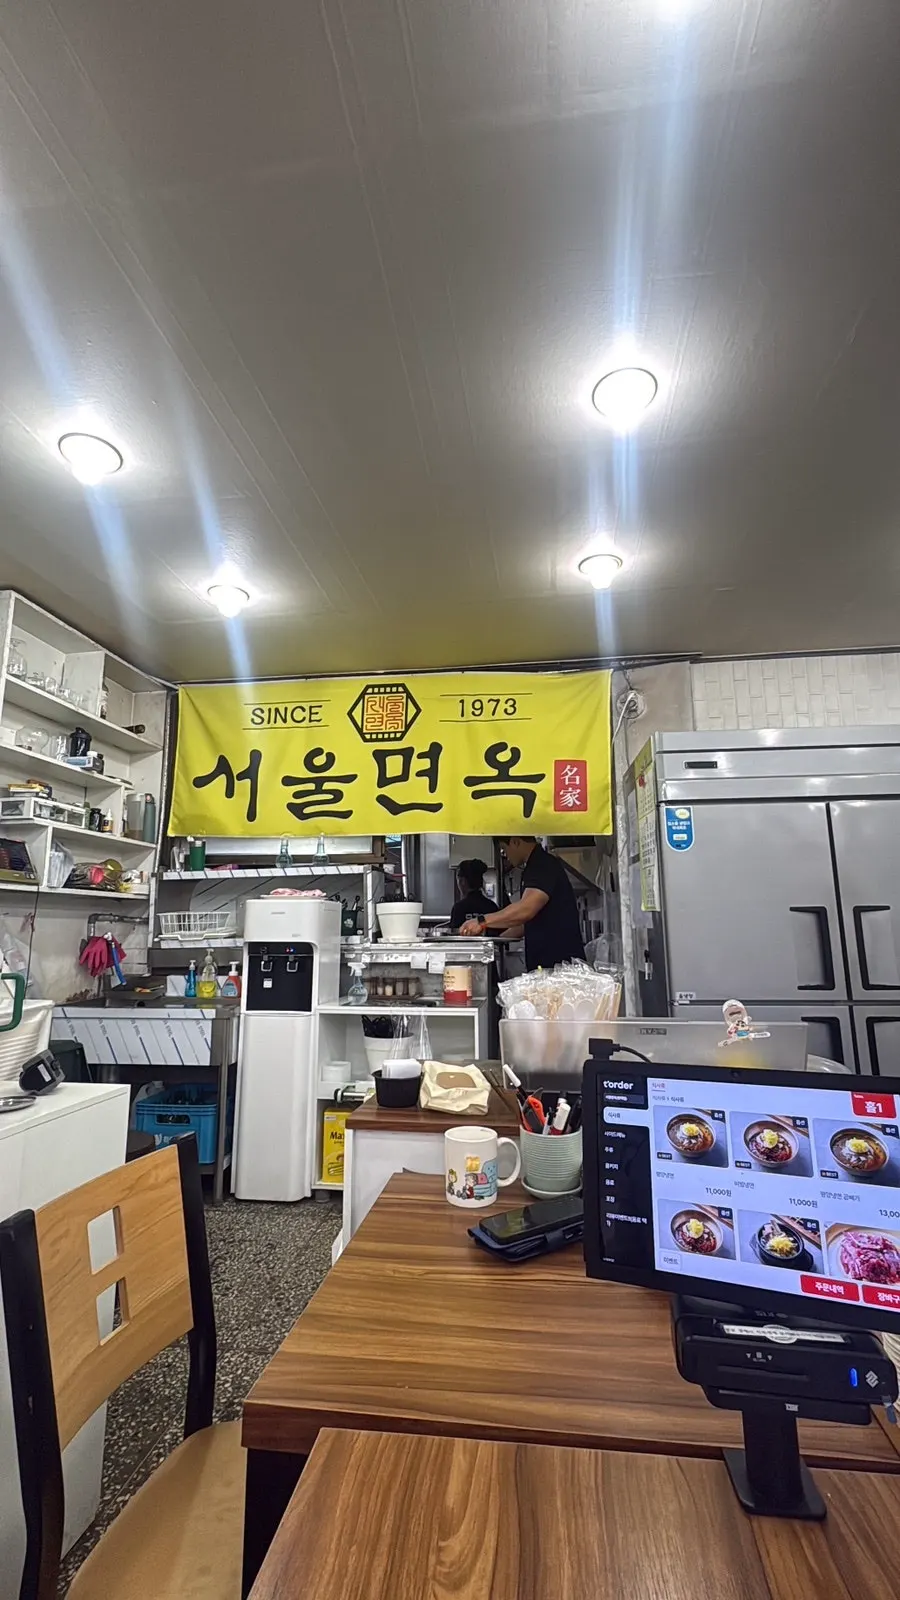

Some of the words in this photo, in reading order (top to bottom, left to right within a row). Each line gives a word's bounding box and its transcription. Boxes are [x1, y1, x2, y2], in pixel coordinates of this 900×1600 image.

[250, 704, 324, 726] SINCE
[458, 698, 518, 719] 1973
[192, 741, 547, 823] 서울면옥
[558, 763, 583, 809] 名家
[865, 1100, 883, 1114] 홀1
[705, 1187, 732, 1197] 11,000원
[789, 1197, 818, 1209] 11,000원
[815, 1282, 844, 1295] 주문내역
